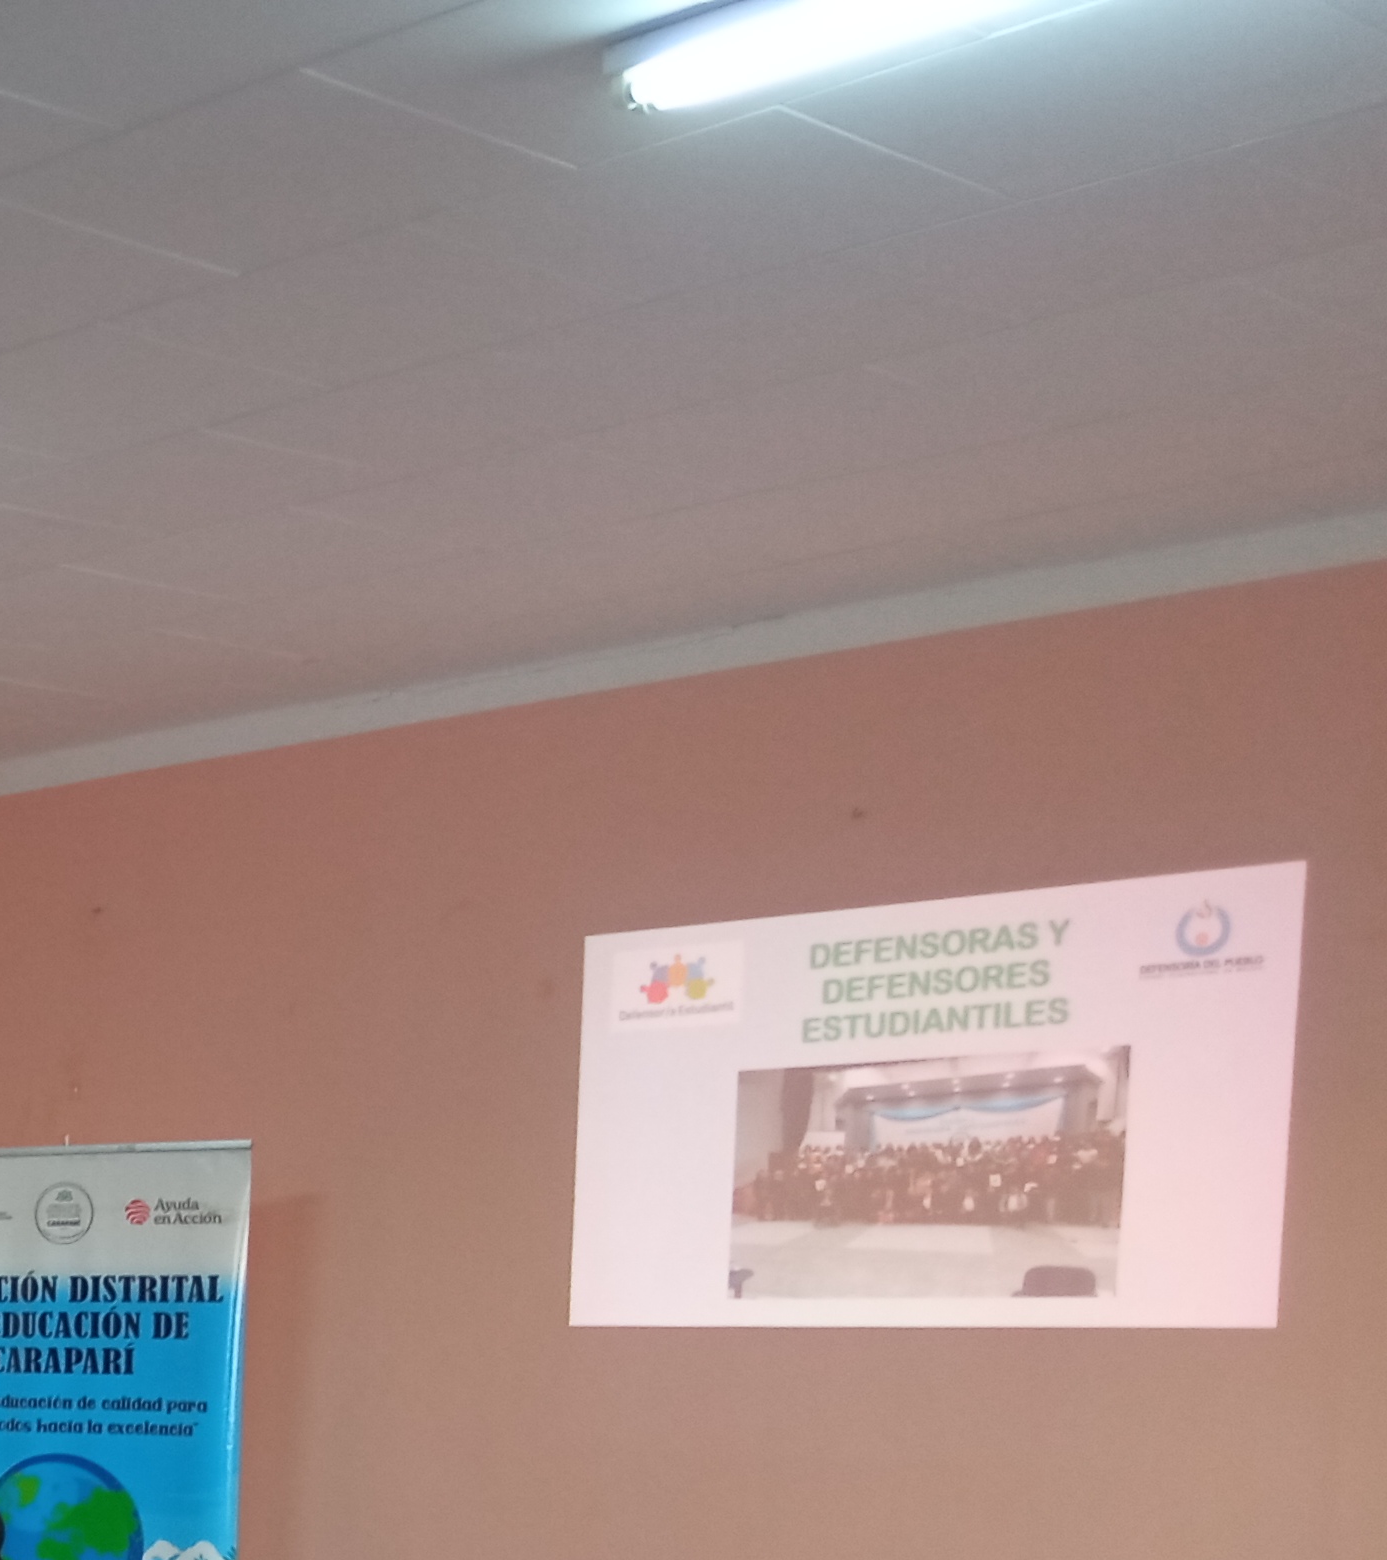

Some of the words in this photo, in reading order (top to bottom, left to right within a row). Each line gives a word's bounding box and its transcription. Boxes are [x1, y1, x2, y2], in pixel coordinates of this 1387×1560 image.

[809, 921, 1040, 969] DEFENSORAS
[1048, 918, 1071, 947] Y
[821, 959, 1051, 1005] DEFENSORES
[801, 998, 1069, 1044] ESTUDIANTILES
[153, 1197, 200, 1213] Ayuda
[153, 1214, 172, 1225] en
[173, 1211, 223, 1225] Acción
[69, 1274, 224, 1303] DISTRITAL
[152, 1312, 189, 1339] DE
[77, 1396, 96, 1410] de
[102, 1397, 163, 1412] calidad
[166, 1399, 208, 1414] para
[36, 1419, 84, 1434] hacia
[87, 1420, 103, 1434] la
